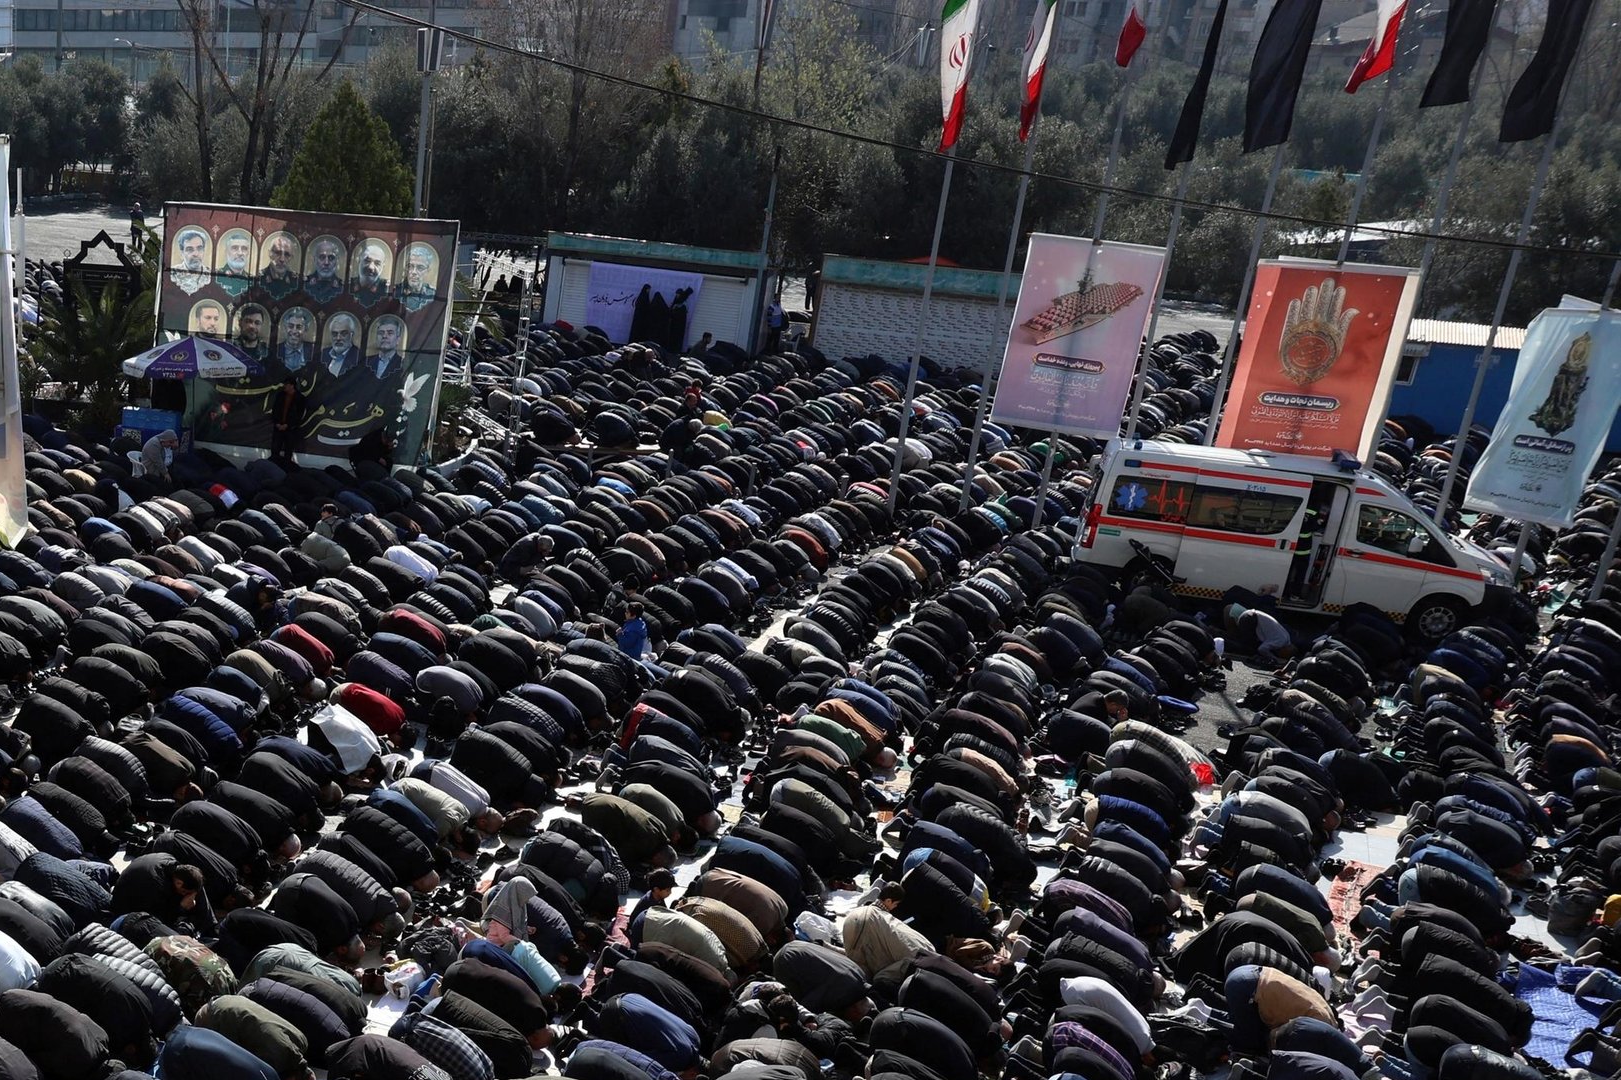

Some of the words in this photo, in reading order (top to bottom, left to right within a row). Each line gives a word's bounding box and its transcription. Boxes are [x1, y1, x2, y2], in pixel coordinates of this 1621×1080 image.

[1263, 395, 1285, 404] هدایت
[1290, 396, 1308, 407] نجات
[1307, 398, 1335, 409] ریسمان
